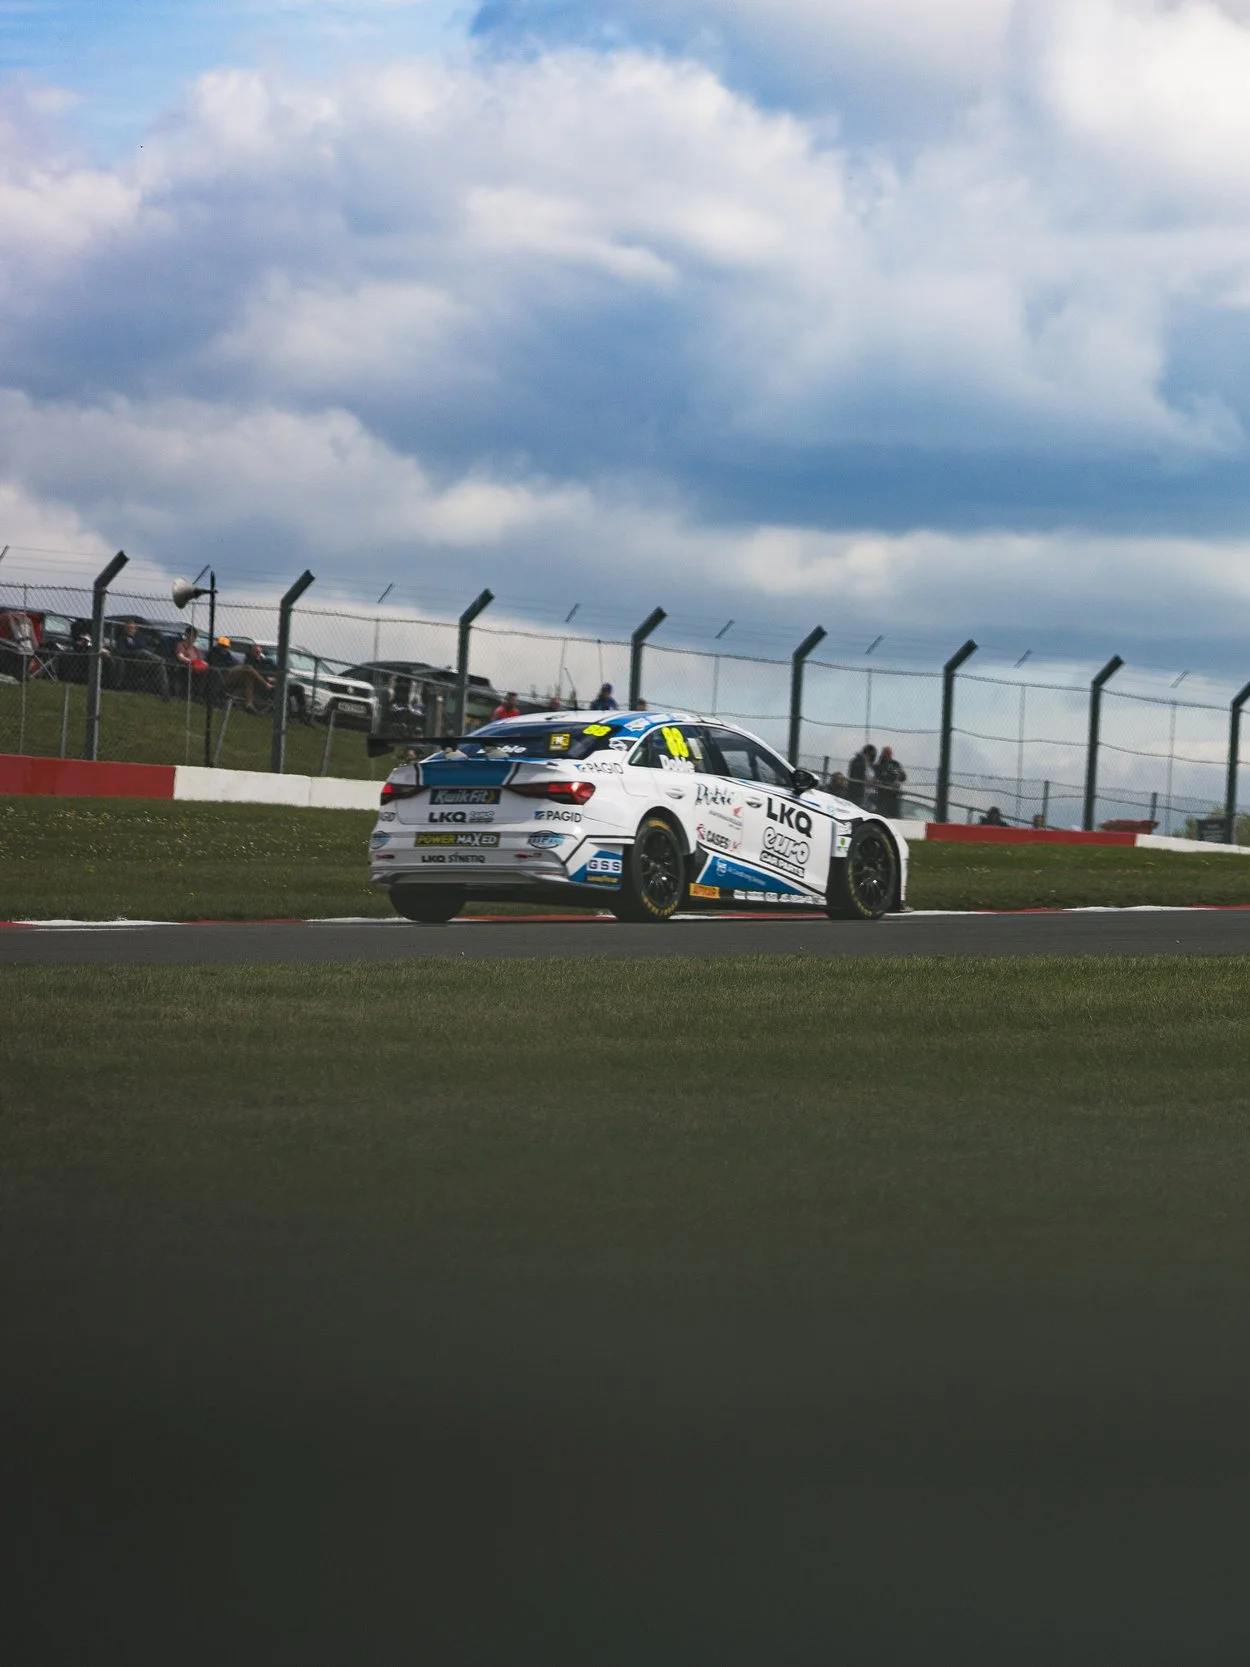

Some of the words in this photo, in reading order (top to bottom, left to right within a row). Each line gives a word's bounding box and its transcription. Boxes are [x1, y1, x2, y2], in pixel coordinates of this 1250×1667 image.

[583, 724, 612, 737] 88
[661, 726, 689, 757] 88
[588, 762, 624, 775] PAGID
[428, 811, 467, 823] LKQ
[546, 811, 582, 823] PAGID
[766, 797, 813, 839] LKQ
[417, 833, 455, 846] POWER
[455, 832, 498, 846] MAXED
[763, 826, 811, 865] euro
[421, 854, 447, 864] LKQ
